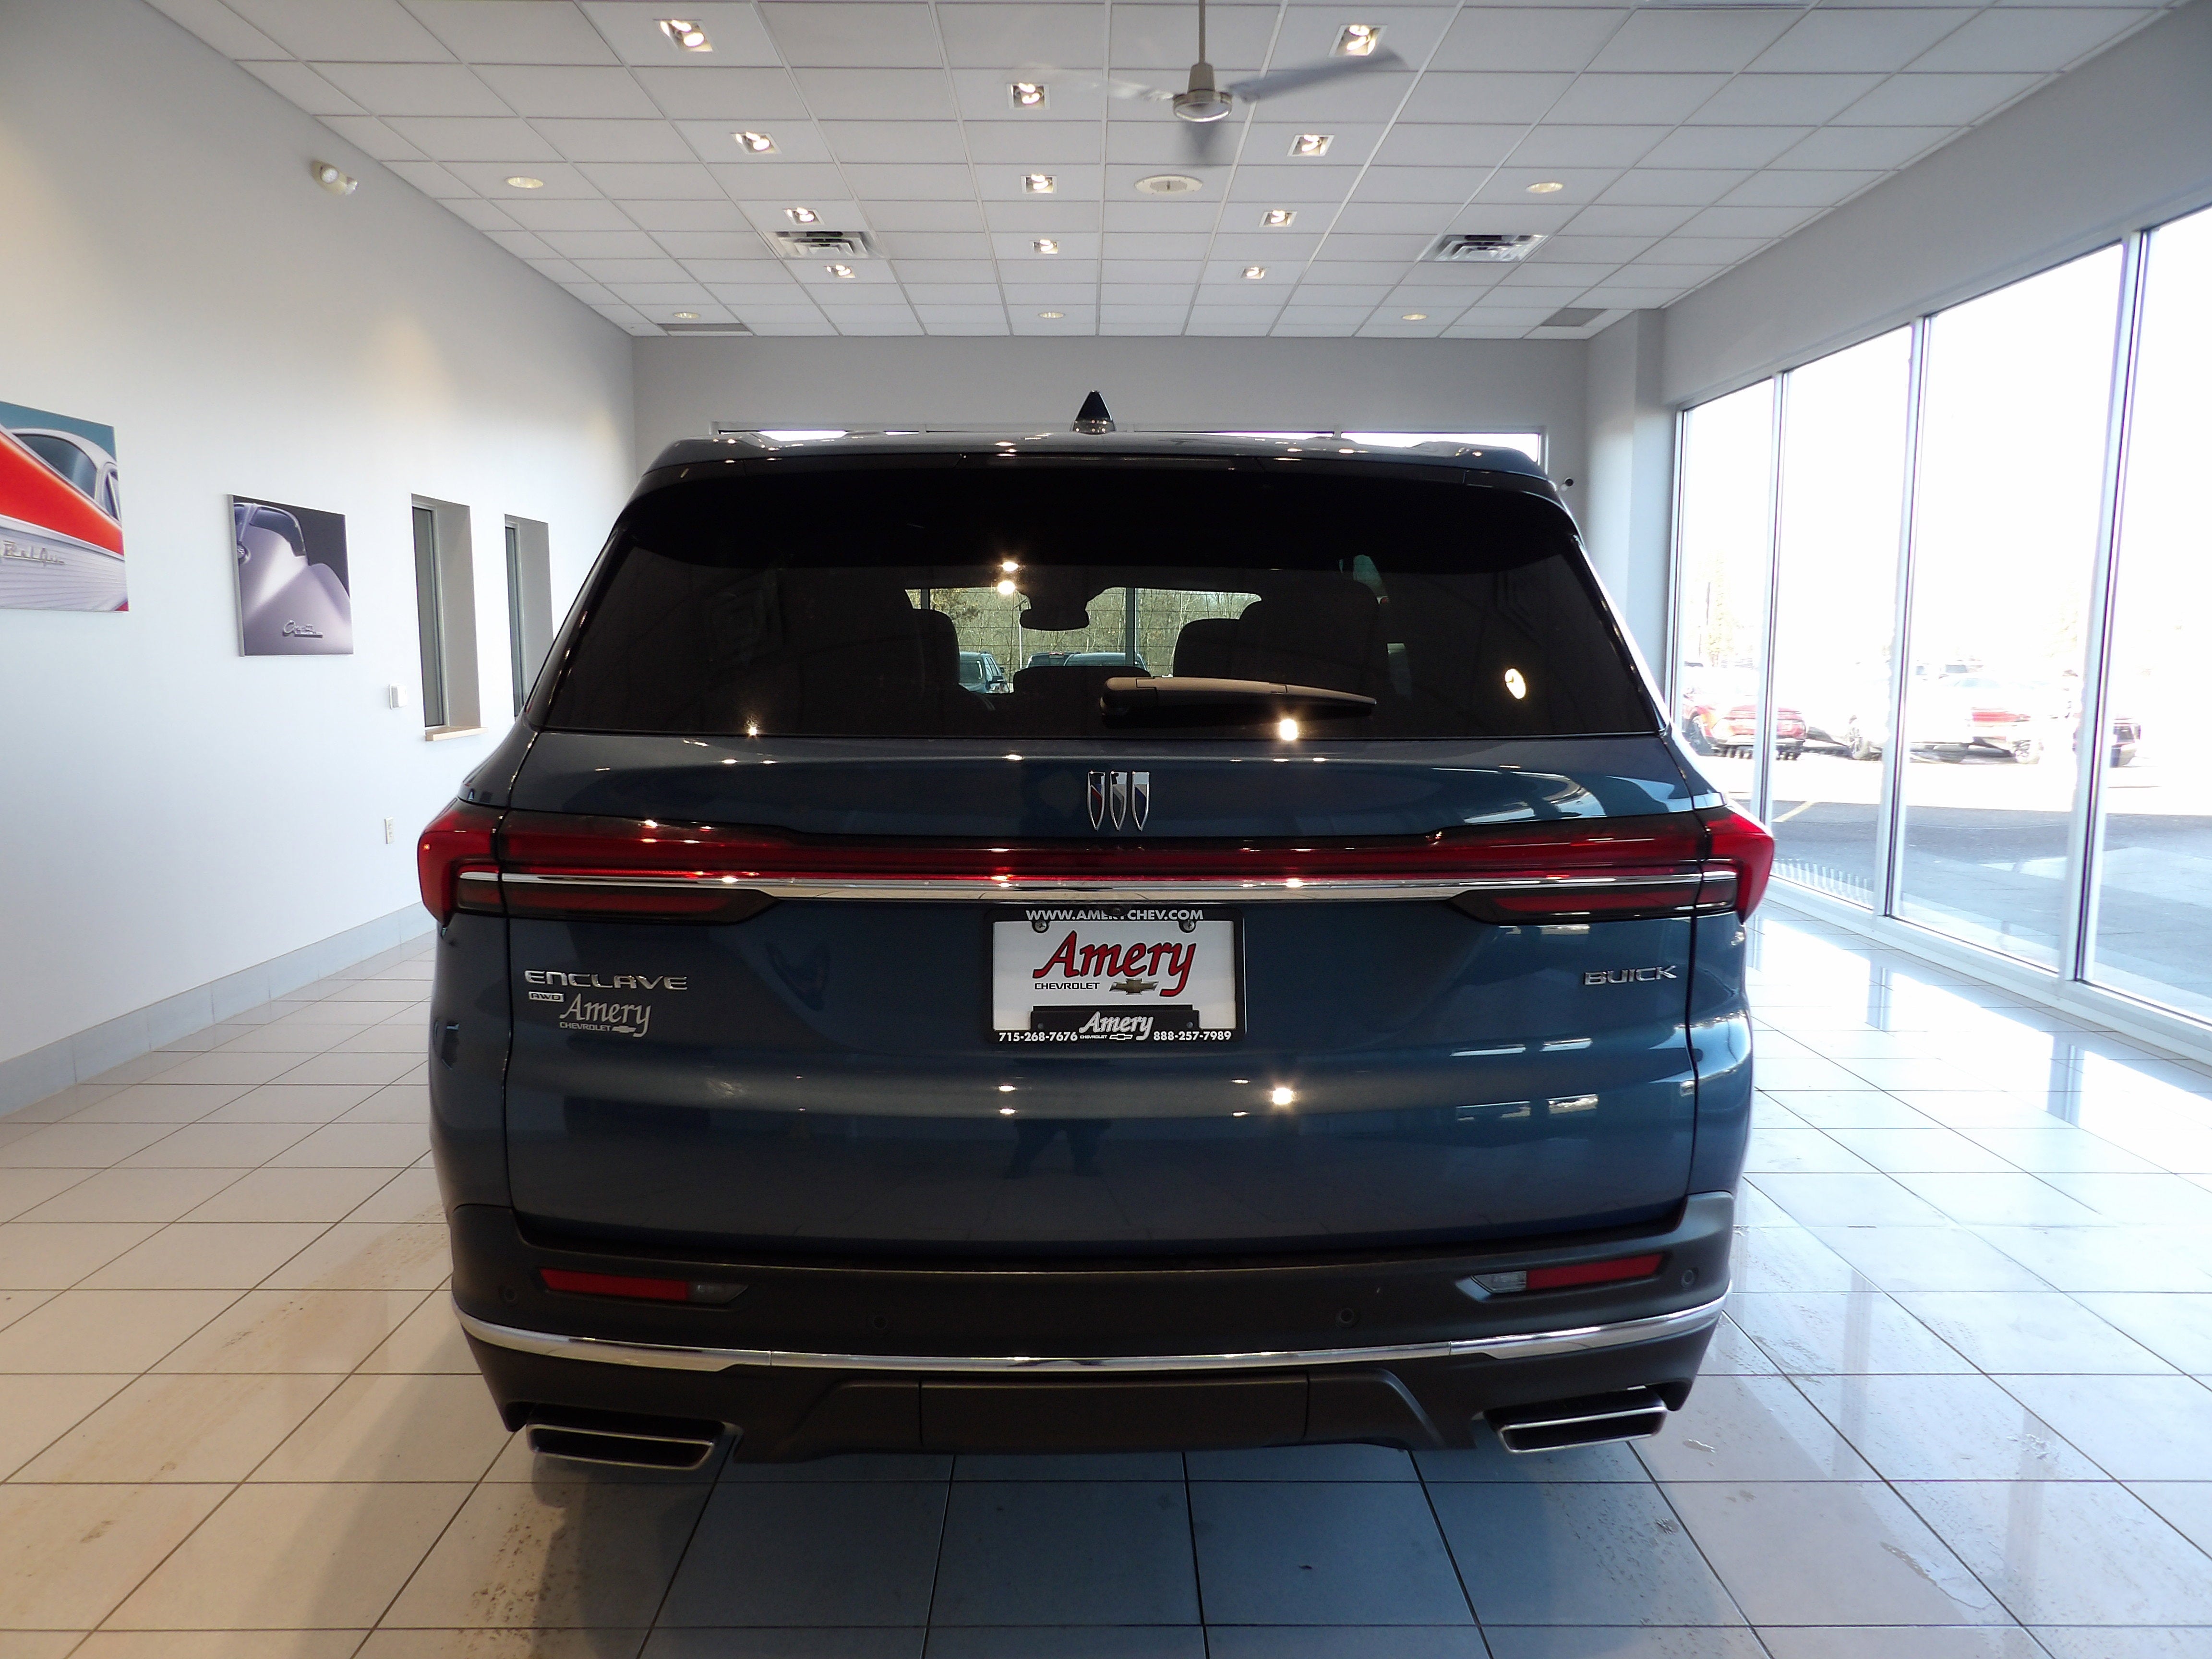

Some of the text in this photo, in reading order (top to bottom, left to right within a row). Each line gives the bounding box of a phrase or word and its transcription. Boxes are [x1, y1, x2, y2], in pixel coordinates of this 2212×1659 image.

[1026, 910, 1203, 920] WWW.AMECHEV.COM
[1032, 930, 1197, 997] Amery
[524, 970, 688, 990] ENCLAVE
[1585, 965, 1677, 985] BUICK
[530, 993, 562, 1001] AWD
[559, 993, 651, 1037] Amery
[560, 1022, 612, 1032] CHEVROLET
[1079, 1011, 1154, 1041] Amery
[999, 1032, 1078, 1042] 715-268-7676
[1154, 1031, 1231, 1041] 888-257-7989
